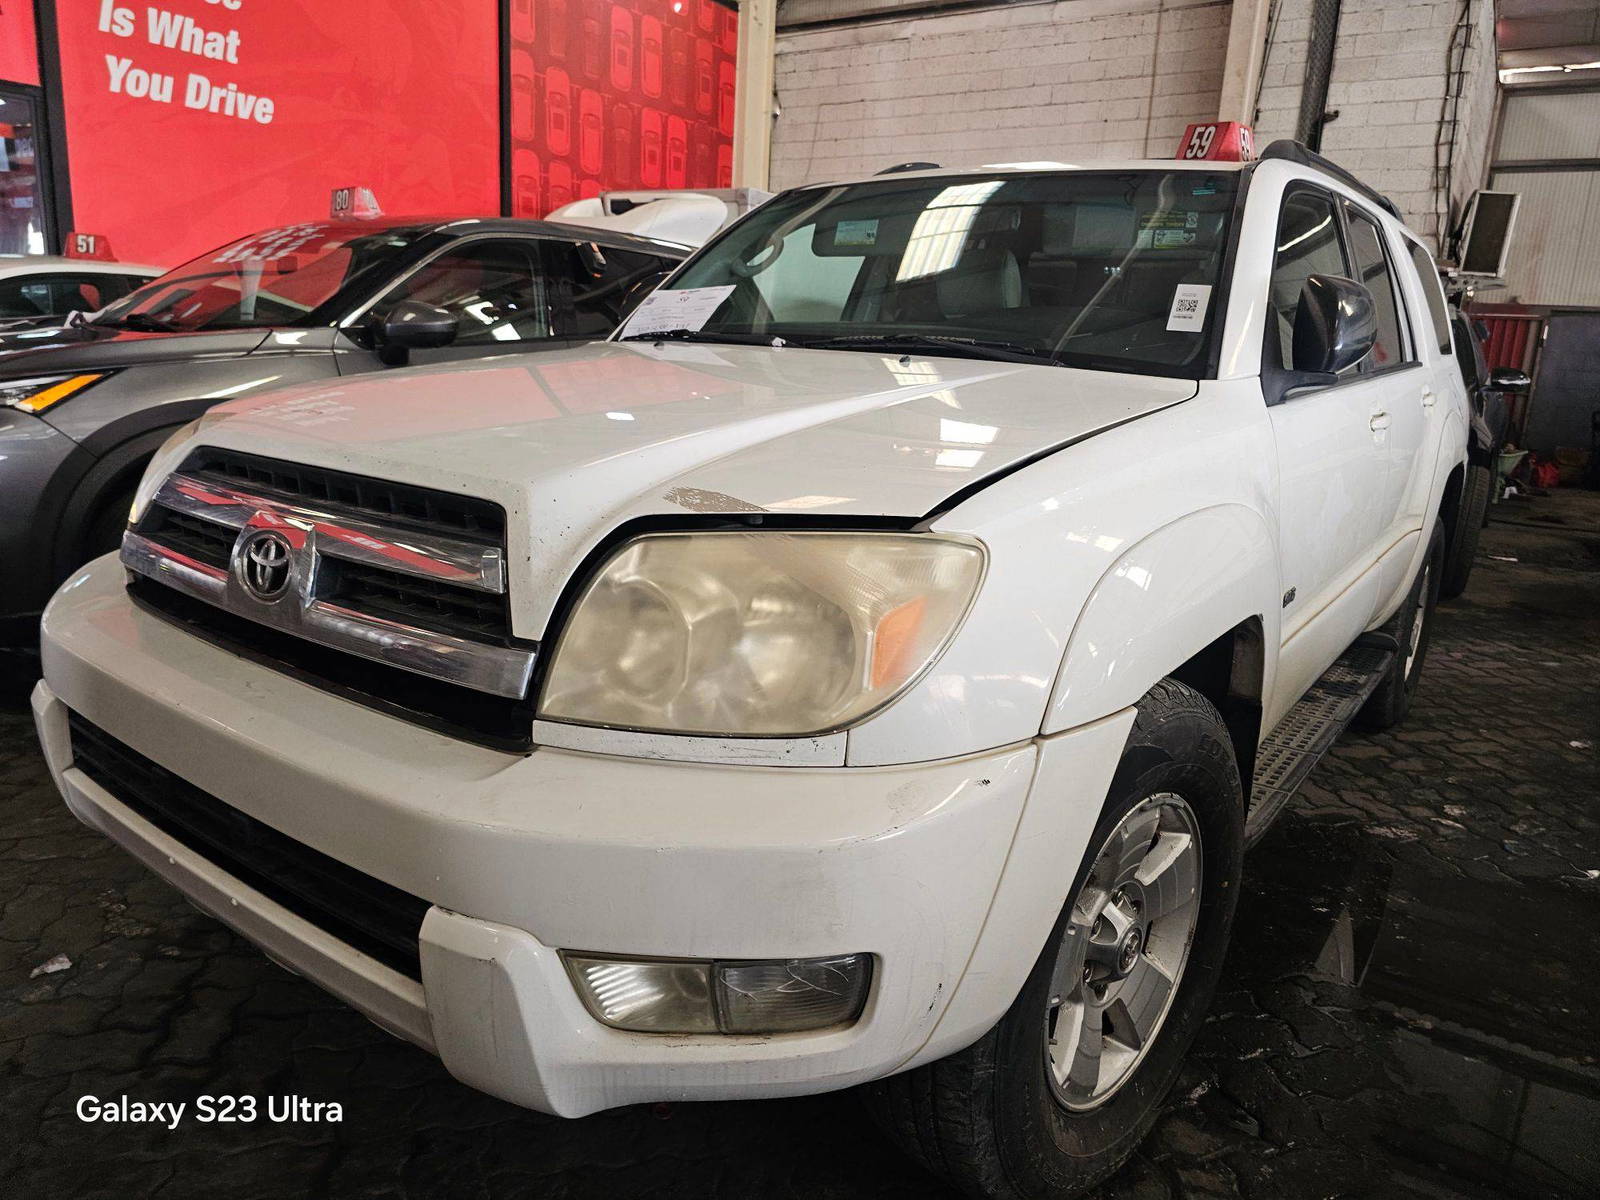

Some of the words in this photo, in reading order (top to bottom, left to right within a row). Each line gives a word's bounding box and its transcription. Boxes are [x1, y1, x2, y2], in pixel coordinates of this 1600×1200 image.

[98, 0, 136, 37] Is
[147, 7, 241, 65] What
[105, 54, 175, 104] You
[184, 73, 275, 124] Drive
[1184, 126, 1217, 159] 59
[335, 189, 350, 211] 80
[76, 234, 96, 255] 51
